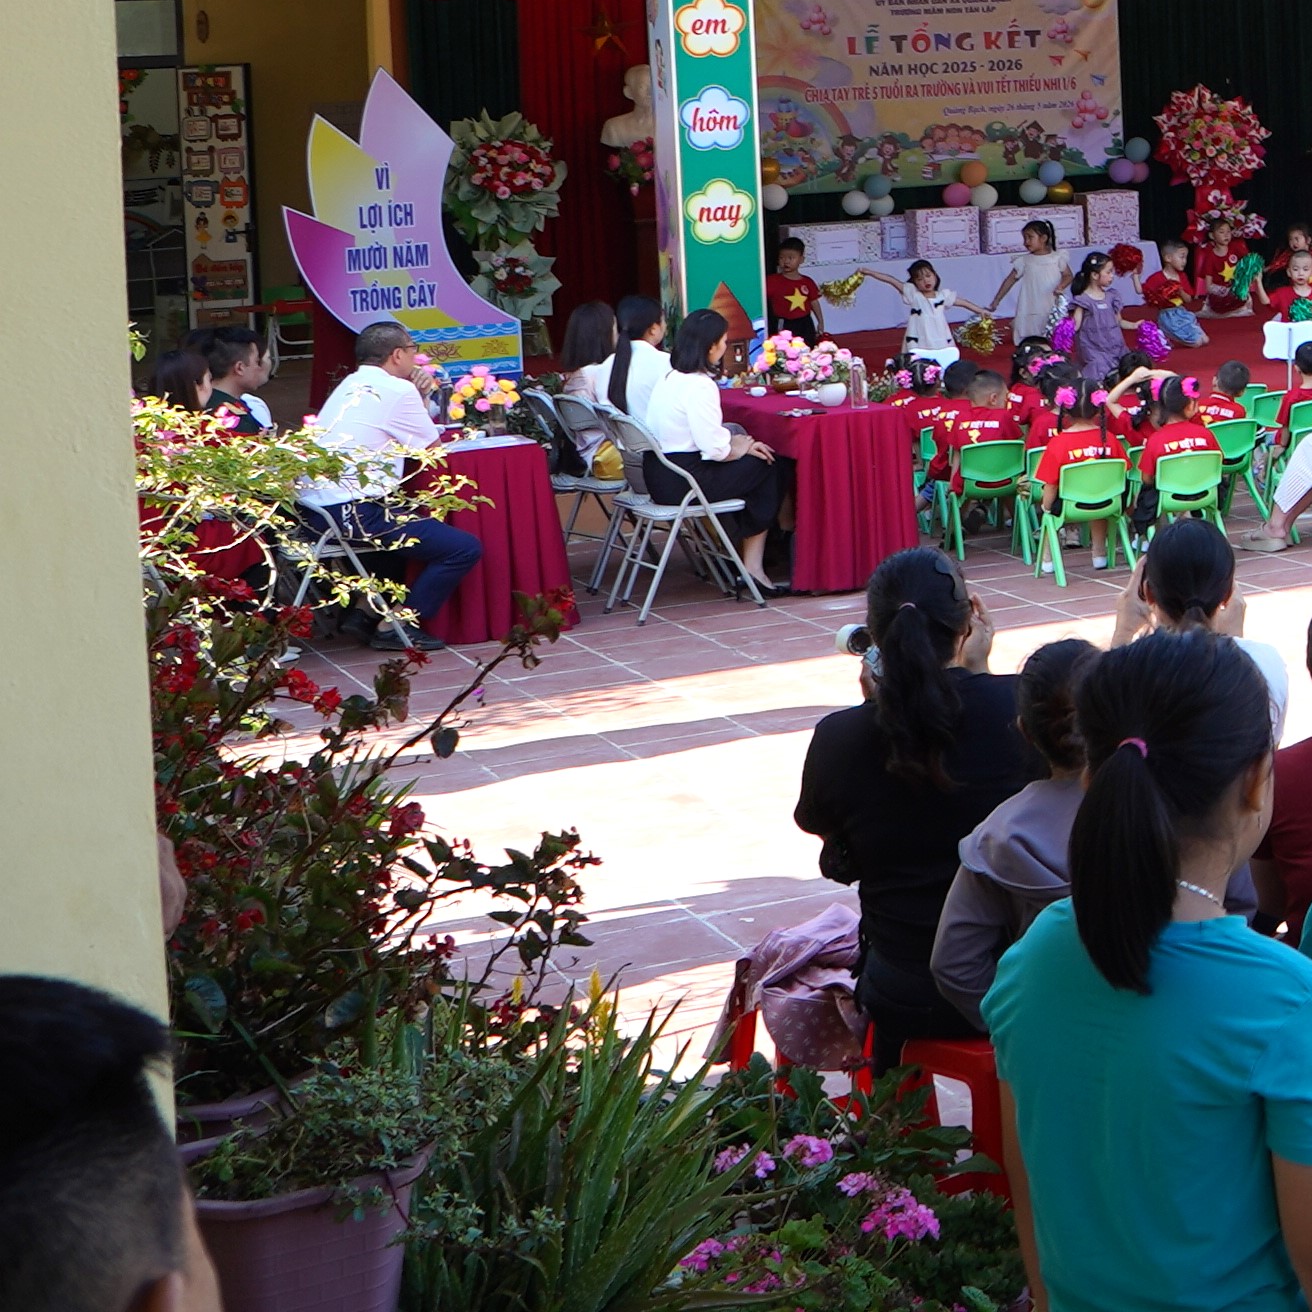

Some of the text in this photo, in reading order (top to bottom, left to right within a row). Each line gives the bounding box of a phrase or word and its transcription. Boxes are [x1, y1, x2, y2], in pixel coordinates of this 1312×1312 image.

[691, 16, 729, 37] em
[846, 18, 1042, 56] LỄ TỔNG KẾT
[868, 59, 904, 77] NĂM
[908, 61, 939, 77] HỌC
[942, 60, 977, 74] 2025
[988, 58, 1023, 72] 2026
[805, 86, 829, 104] CHIA
[832, 85, 849, 101] TAY
[852, 84, 871, 101] TRẺ
[872, 87, 878, 100] 5
[879, 82, 904, 100] TUỔI
[905, 86, 920, 98] RA
[921, 82, 959, 97] TRƯỜNG
[960, 81, 976, 96] VÀ
[977, 82, 998, 96] VUI
[999, 77, 1012, 94] TẾT
[1013, 76, 1041, 94] THIẾU
[1042, 79, 1062, 92] NHI
[692, 106, 740, 133] hôm
[375, 162, 391, 191] VÌ
[359, 199, 414, 232] LỢI ÍCH
[698, 202, 742, 228] nay
[346, 239, 429, 274] MƯỜI NĂM
[349, 277, 437, 314] TRỒNG CÂY
